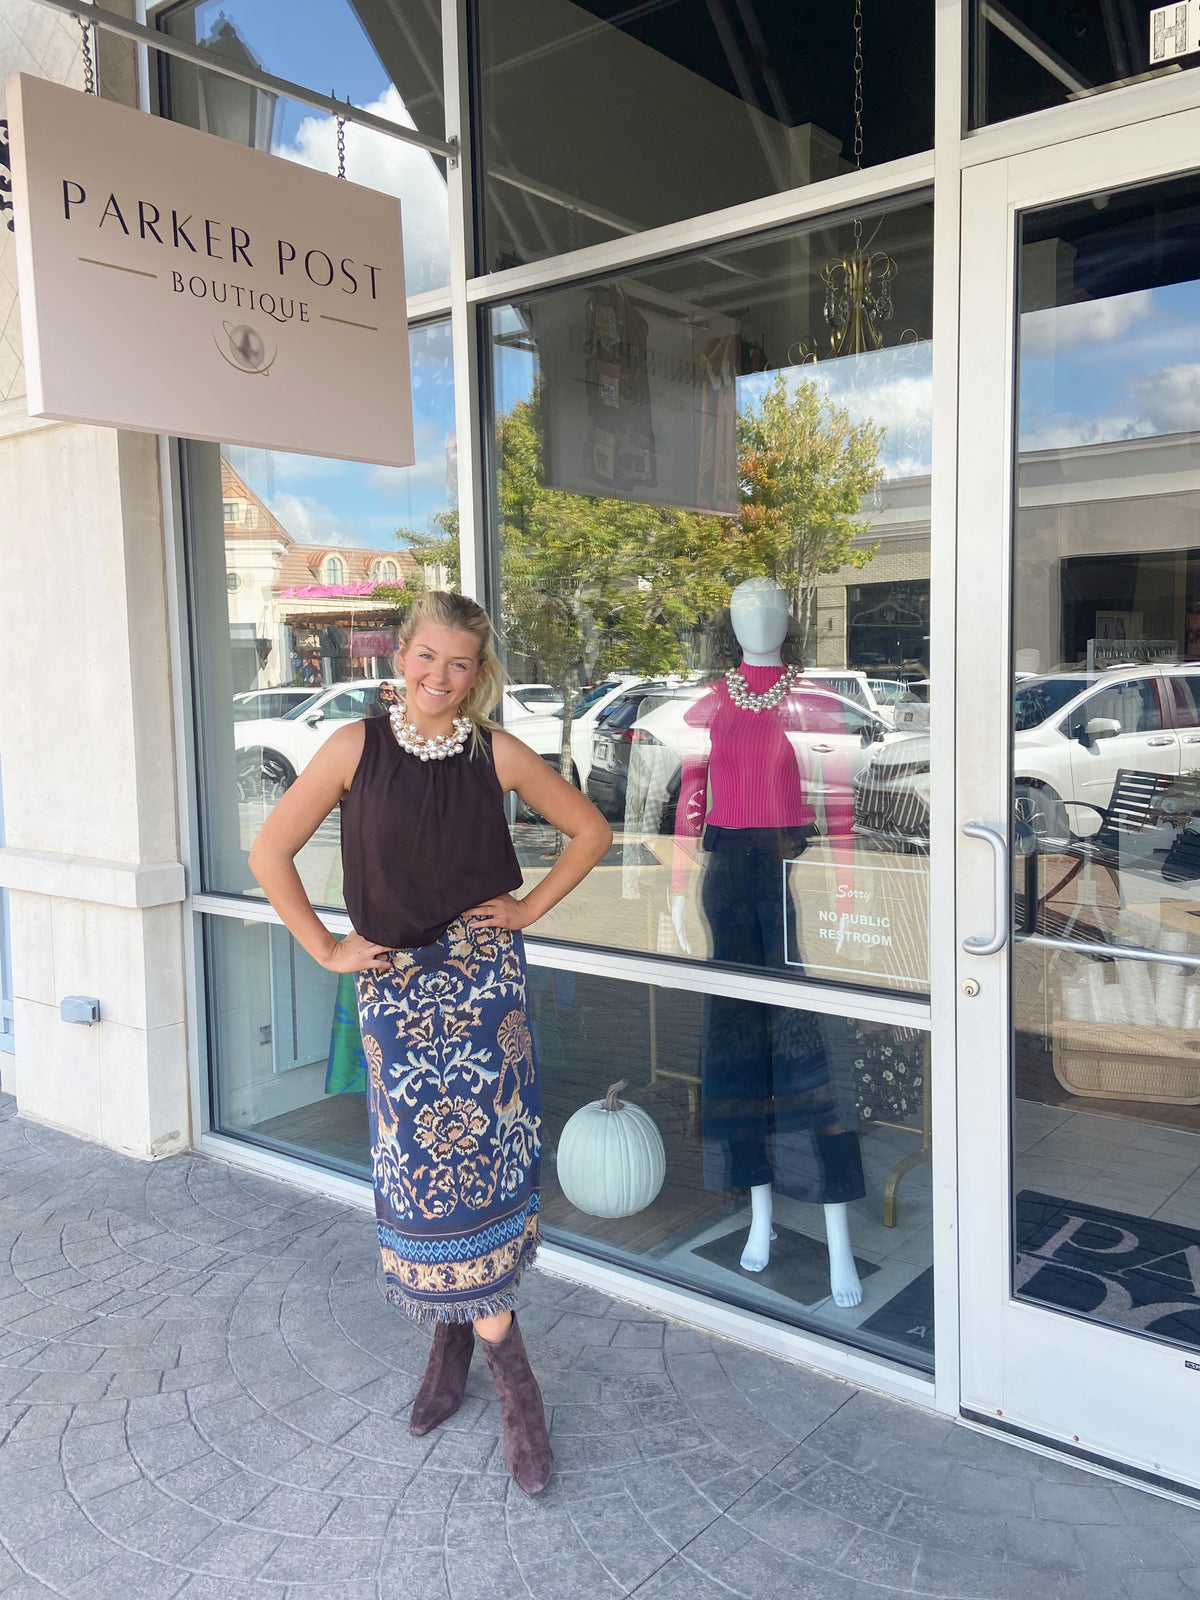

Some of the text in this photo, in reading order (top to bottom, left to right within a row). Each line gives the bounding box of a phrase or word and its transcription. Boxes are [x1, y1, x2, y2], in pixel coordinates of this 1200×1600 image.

[62, 179, 383, 300] PARKER POST
[172, 270, 311, 323] BOUTIQUE
[835, 884, 872, 903] Sorry
[818, 910, 891, 928] NO PUBLIC
[819, 928, 893, 947] RESTROOM
